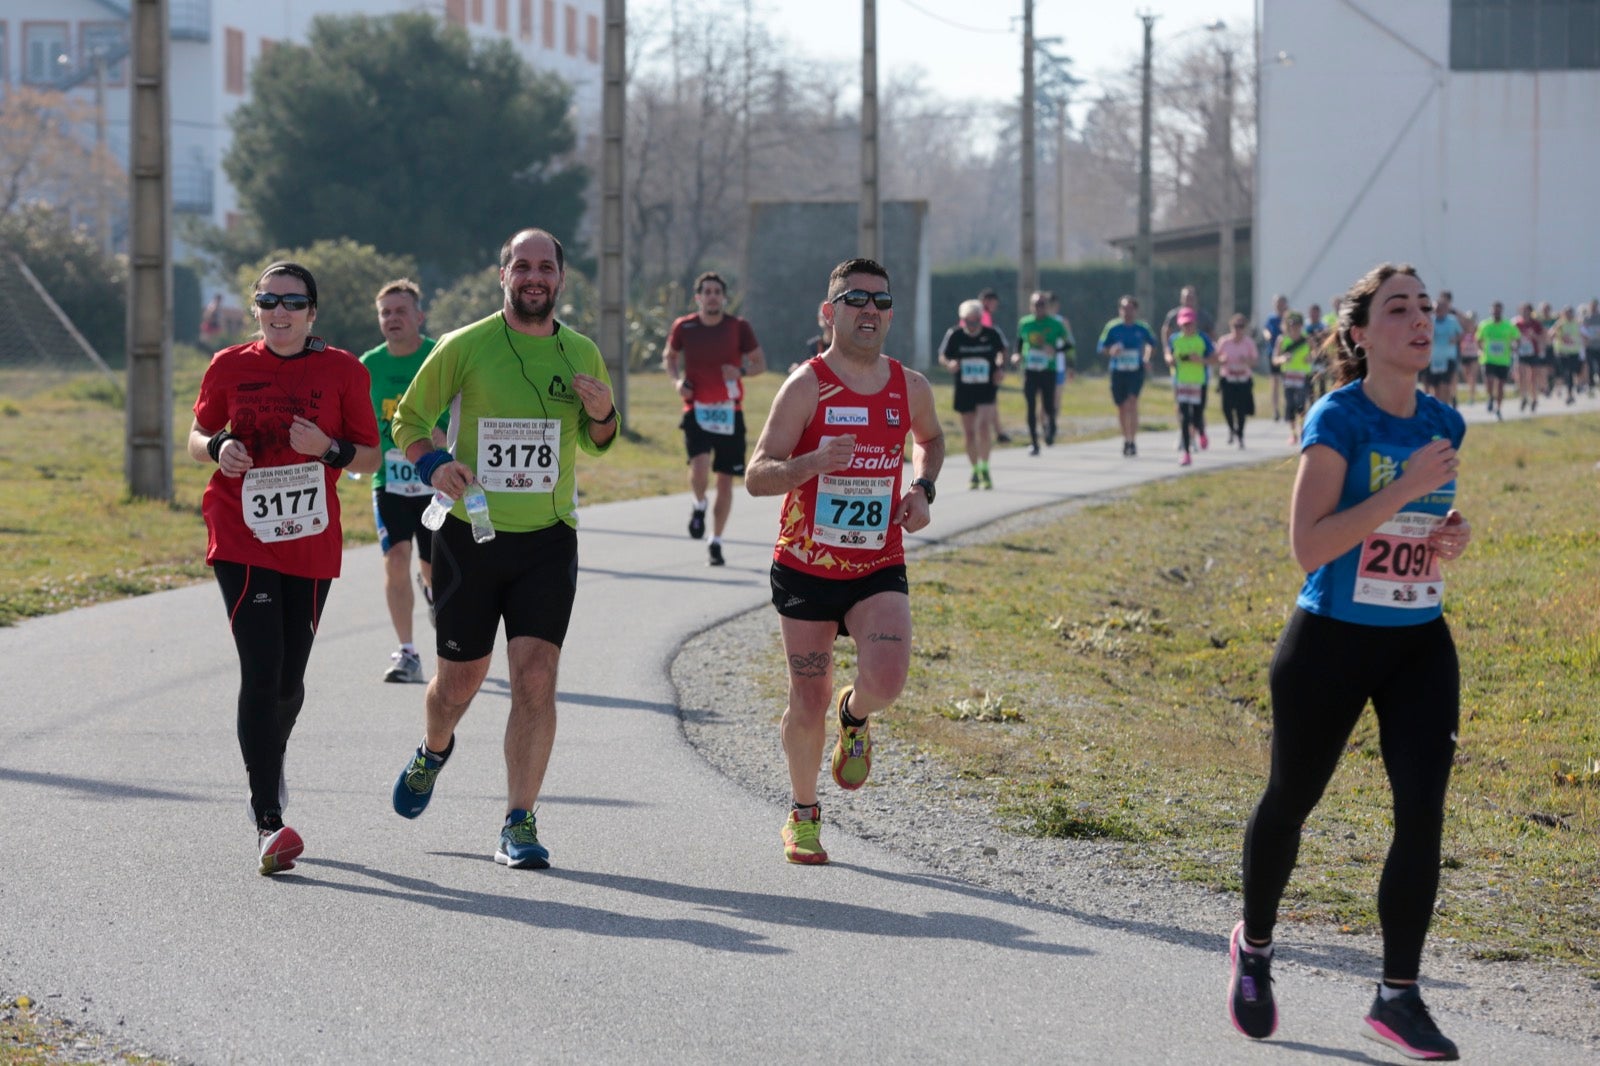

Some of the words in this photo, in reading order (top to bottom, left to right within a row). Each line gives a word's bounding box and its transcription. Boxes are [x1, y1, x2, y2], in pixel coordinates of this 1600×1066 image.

[487, 443, 552, 468] 3178
[848, 451, 901, 470] isalud
[854, 443, 885, 453] línicas
[252, 487, 318, 518] 3177
[830, 498, 883, 527] 728
